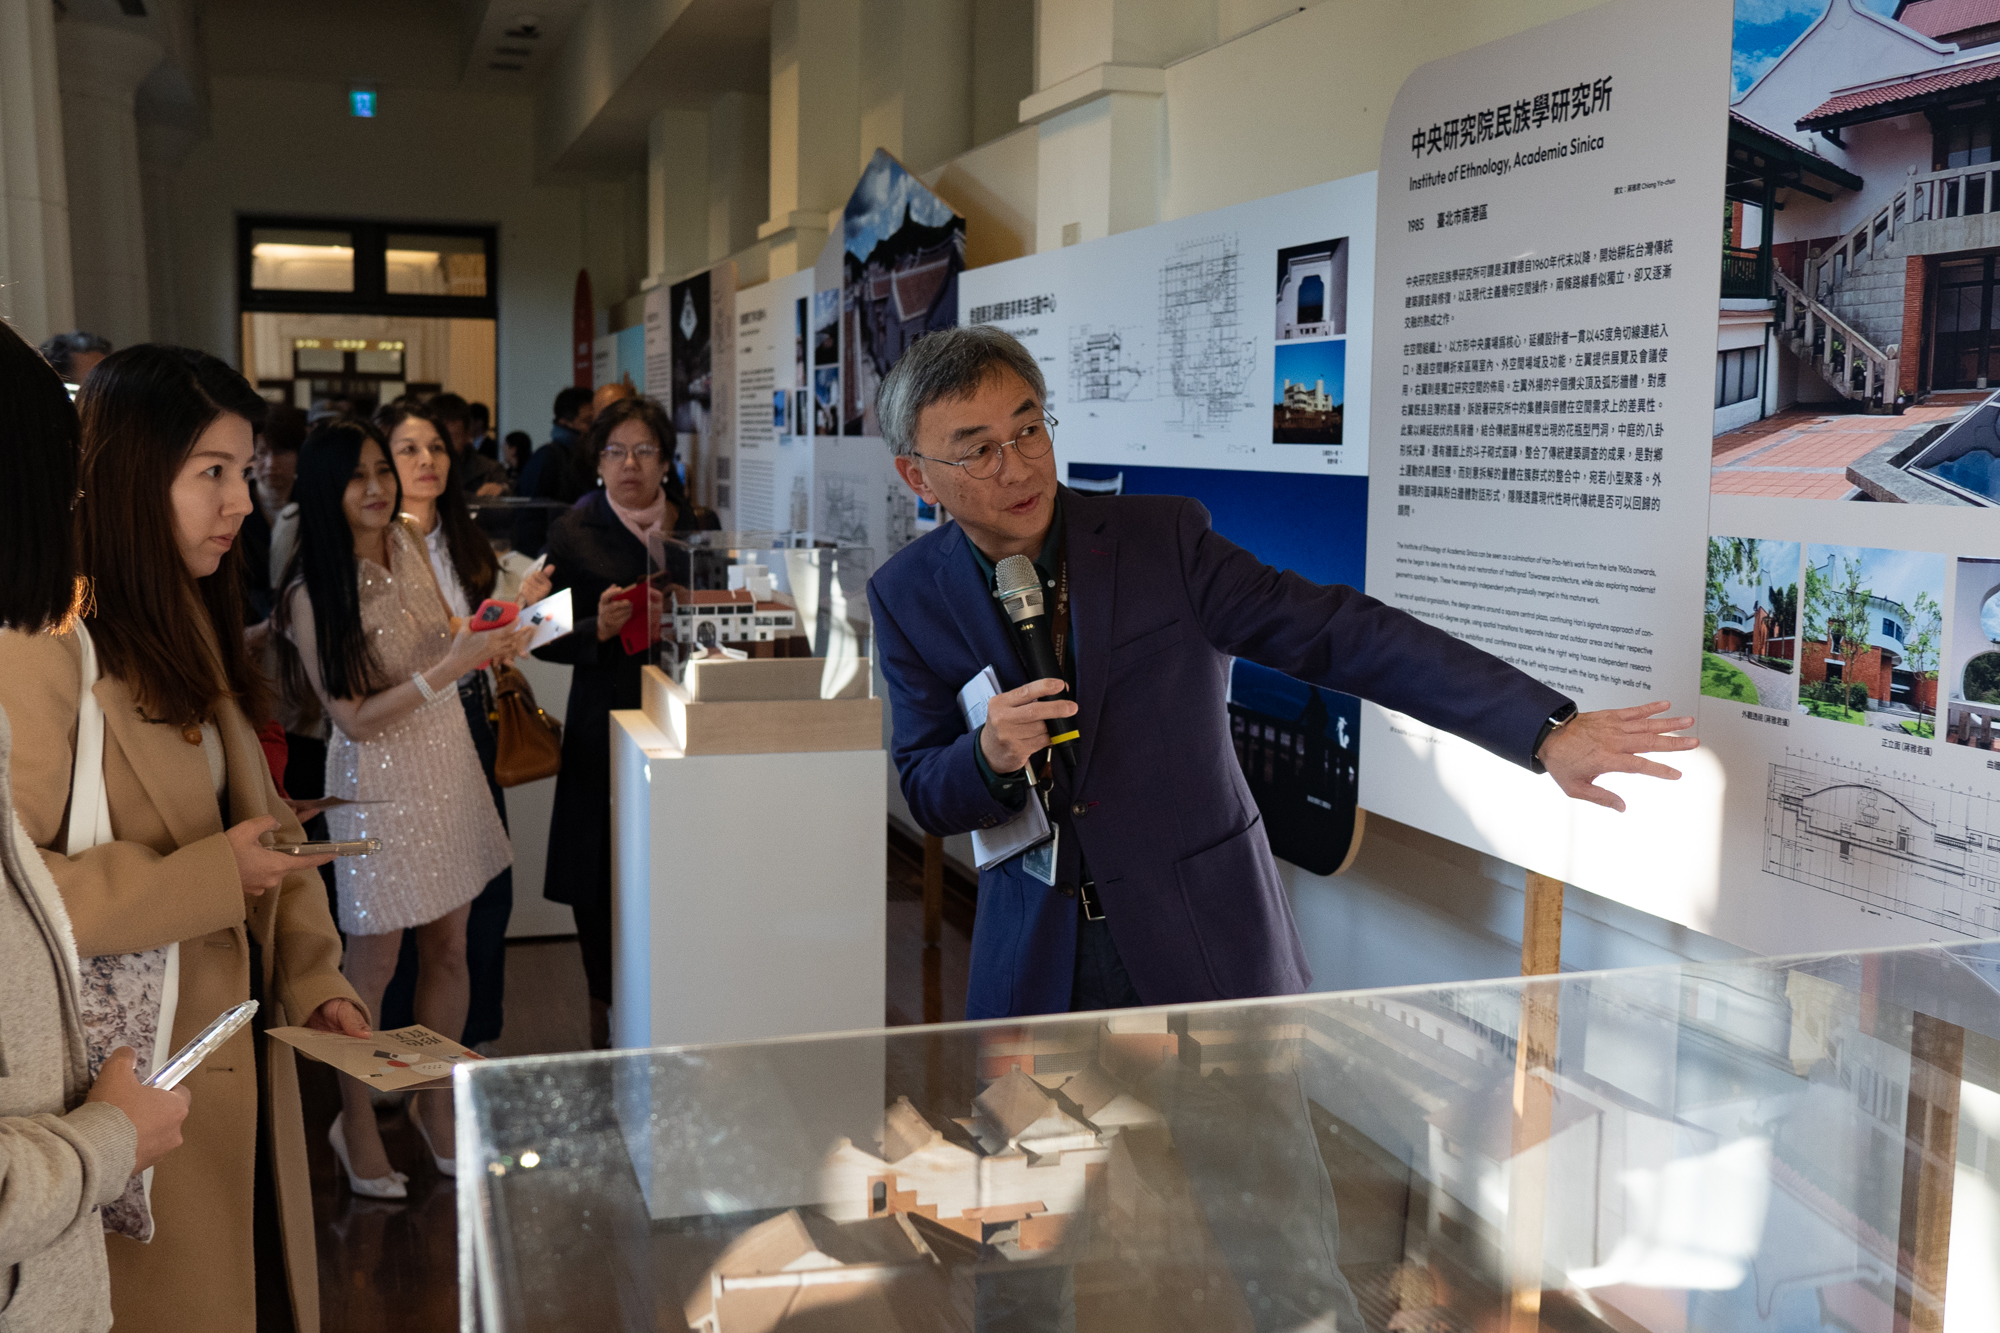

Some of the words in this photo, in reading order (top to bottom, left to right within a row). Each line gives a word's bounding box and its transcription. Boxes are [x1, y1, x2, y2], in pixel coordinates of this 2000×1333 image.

[1410, 76, 1612, 158] 中央研究院民族學研究所
[1410, 169, 1446, 191] Institute
[1448, 166, 1458, 182] of
[1460, 154, 1512, 180] Ethnology,
[1513, 146, 1568, 168] Academia
[1570, 134, 1604, 156] Sinica
[1408, 218, 1424, 232] 1985
[1436, 204, 1488, 229] 臺北市南港區
[1607, 564, 1616, 572] late
[1617, 565, 1632, 573] 1960s
[1633, 569, 1656, 577] onwards,
[1504, 570, 1526, 578] traditional
[1528, 572, 1549, 581] Taiwanese
[1551, 576, 1580, 585] architecture,
[1594, 580, 1604, 588] also
[1605, 582, 1628, 592] exploring
[1629, 585, 1655, 594] modernist
[1516, 588, 1536, 596] gradually
[1537, 591, 1554, 599] merged
[1535, 613, 1548, 621] plaza,
[1549, 615, 1572, 626] continuing
[1573, 619, 1586, 627] Han's
[1586, 621, 1609, 630] signature
[1610, 626, 1633, 634] approach
[1614, 642, 1625, 650] their
[1626, 646, 1652, 655] respective
[1556, 650, 1567, 658] right
[1568, 652, 1579, 661] wing
[1580, 653, 1596, 662] houses
[1597, 657, 1628, 668] independent
[1629, 664, 1652, 672] research
[1537, 662, 1547, 671] wing
[1548, 664, 1567, 673] contrast
[1587, 671, 1598, 681] long,
[1610, 676, 1620, 685] high
[1622, 679, 1634, 687] walls
[1642, 682, 1651, 690] the
[1564, 684, 1584, 693] institute.
[1882, 738, 1900, 750] 正立面
